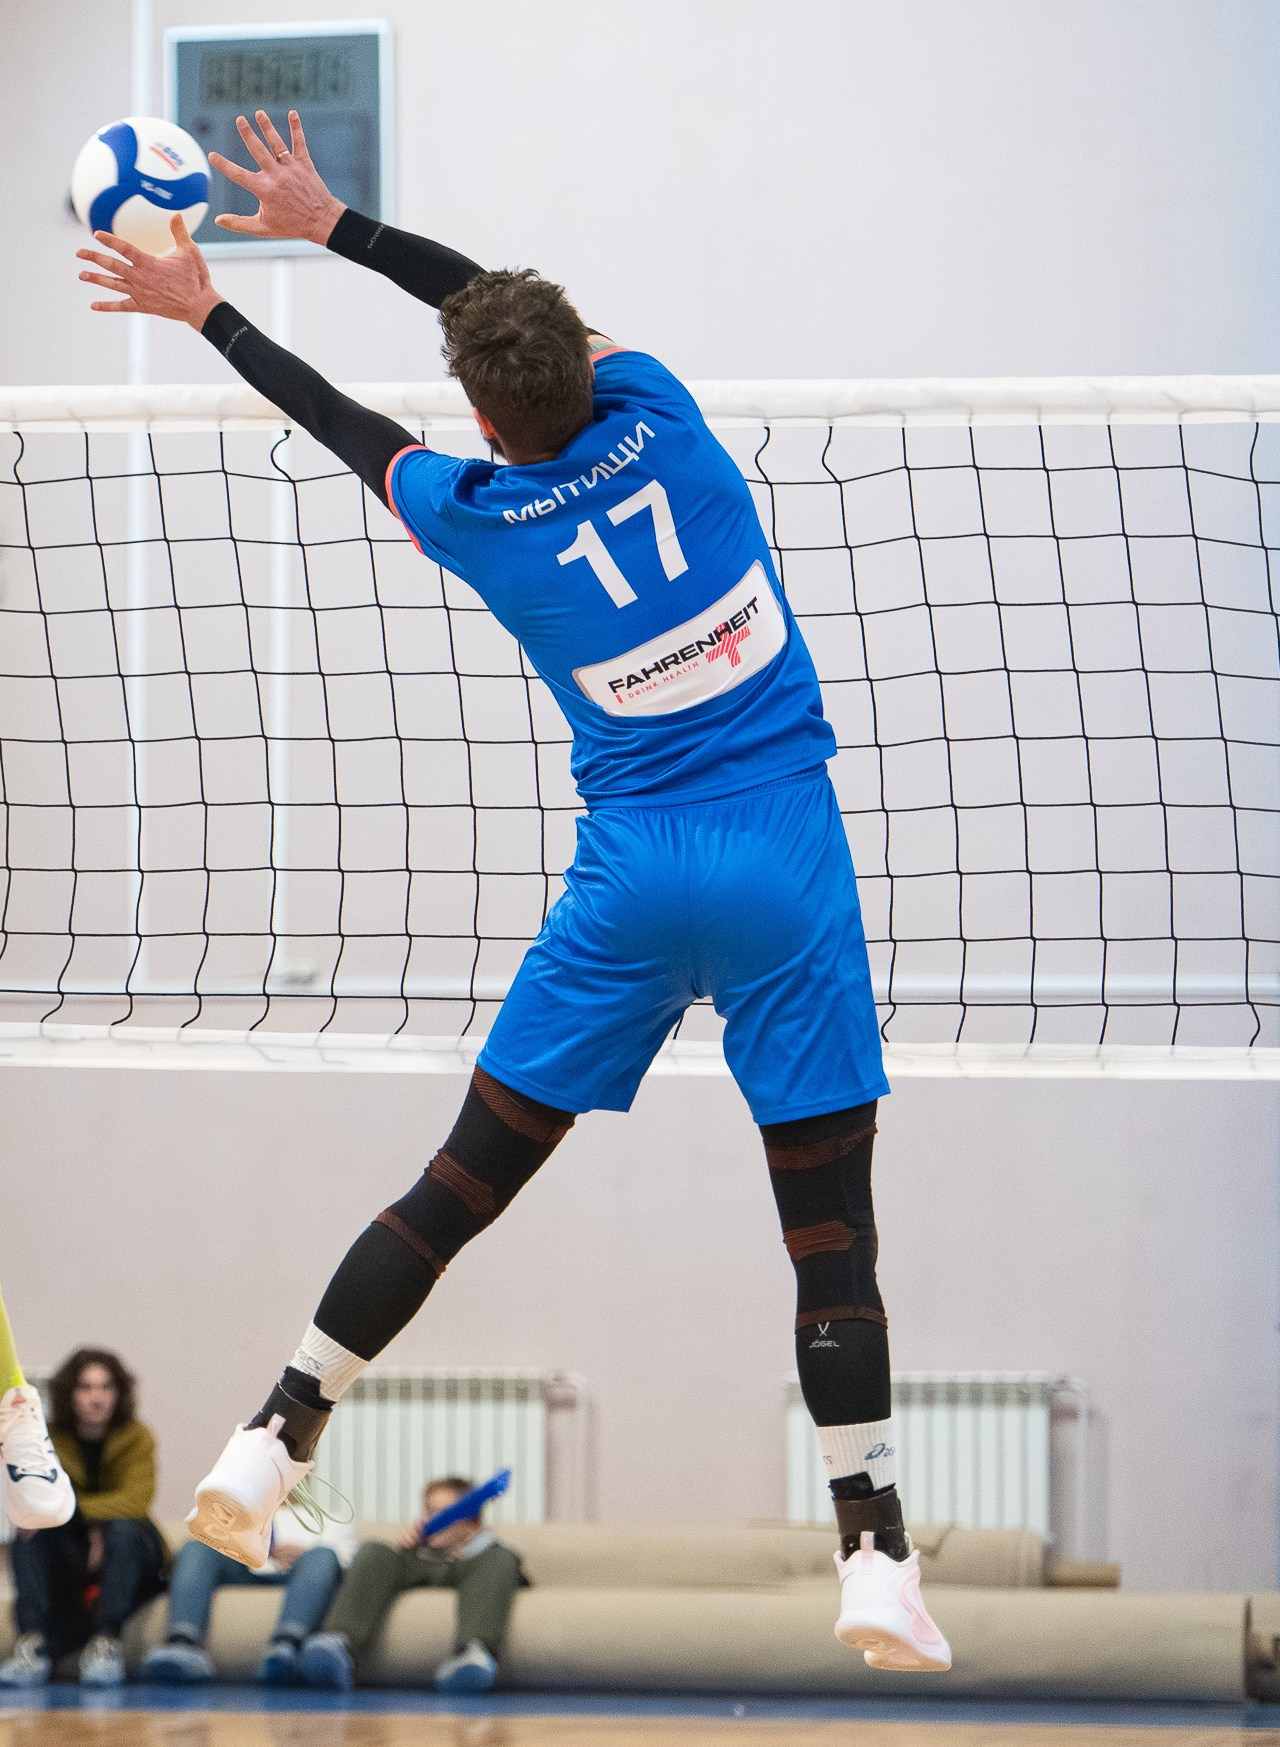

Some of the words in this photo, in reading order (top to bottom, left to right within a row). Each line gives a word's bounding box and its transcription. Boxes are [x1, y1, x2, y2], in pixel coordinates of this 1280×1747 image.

[503, 421, 656, 524] МЫТИЩИ
[556, 479, 689, 609] 17
[608, 596, 759, 694] FAHRENHEIT
[628, 681, 658, 699] DRINK
[663, 661, 700, 683] HEALTH
